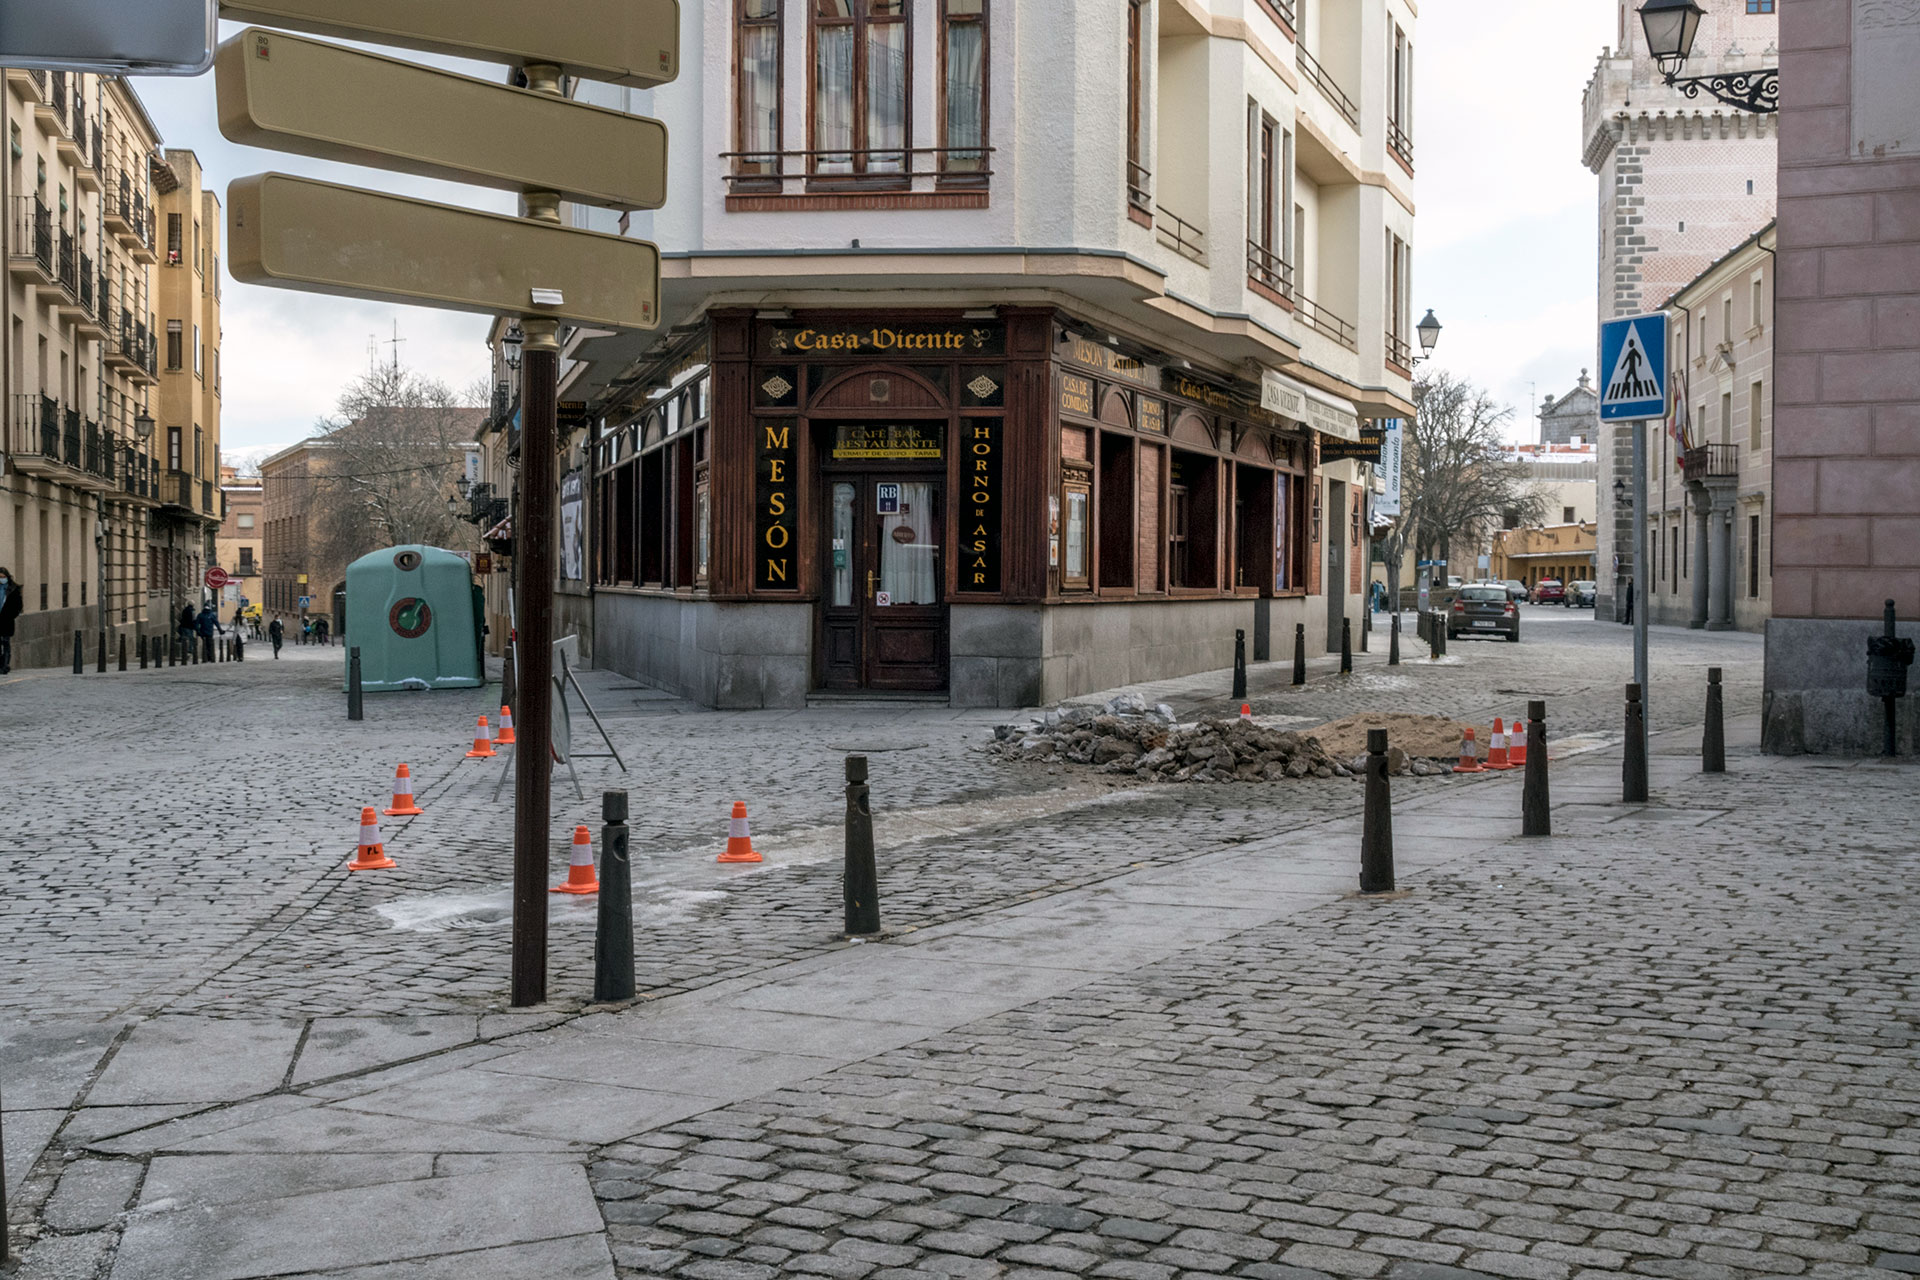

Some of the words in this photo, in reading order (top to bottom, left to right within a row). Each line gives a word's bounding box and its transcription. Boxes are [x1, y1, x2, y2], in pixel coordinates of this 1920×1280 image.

[794, 329, 861, 349] Casa
[871, 328, 965, 349] Vicente
[1180, 378, 1201, 399] Casa
[1267, 383, 1280, 405] CASA
[1061, 393, 1089, 414] COMIDAS
[851, 428, 887, 438] CAFÉ
[894, 430, 921, 438] BAR
[836, 440, 937, 449] RESTAURANTE
[1391, 436, 1400, 474] encanto
[972, 427, 991, 503] HORNO
[880, 486, 897, 499] RB
[1391, 476, 1399, 492] con
[765, 426, 789, 582] MESÓN
[975, 508, 985, 517] DE
[972, 524, 988, 584] ASAR
